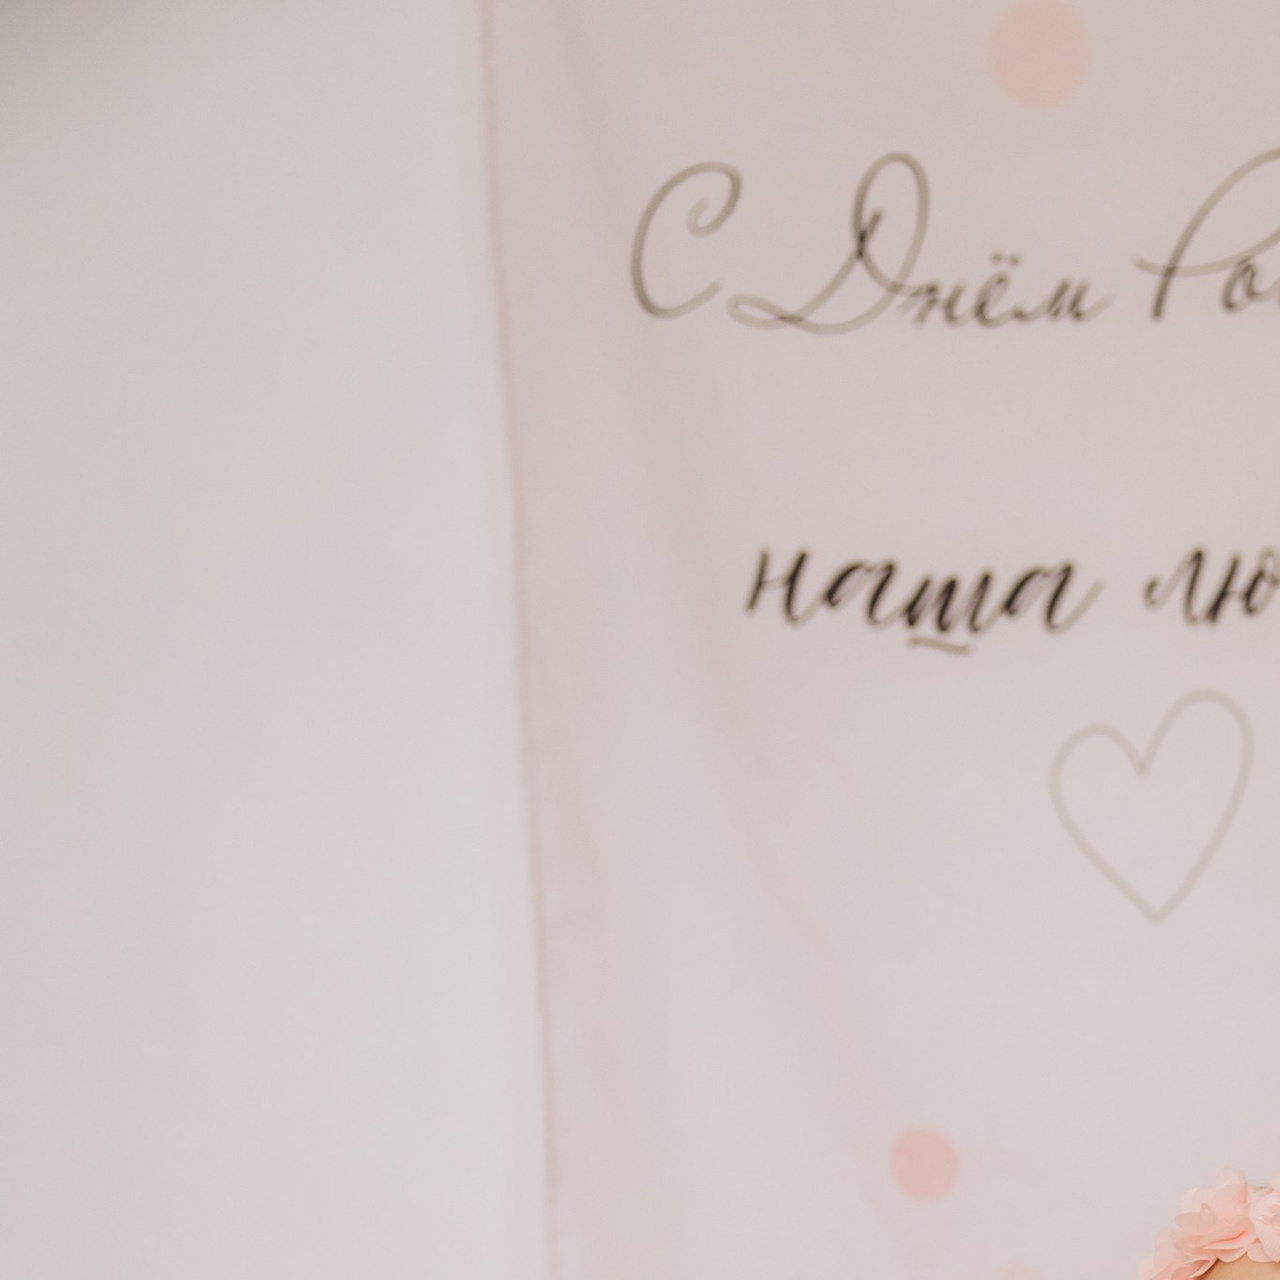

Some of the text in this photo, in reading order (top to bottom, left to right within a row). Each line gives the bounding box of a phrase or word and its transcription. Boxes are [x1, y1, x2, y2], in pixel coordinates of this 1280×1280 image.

[630, 161, 742, 318] С
[727, 152, 1112, 335] Днём
[743, 544, 1105, 655] наша
